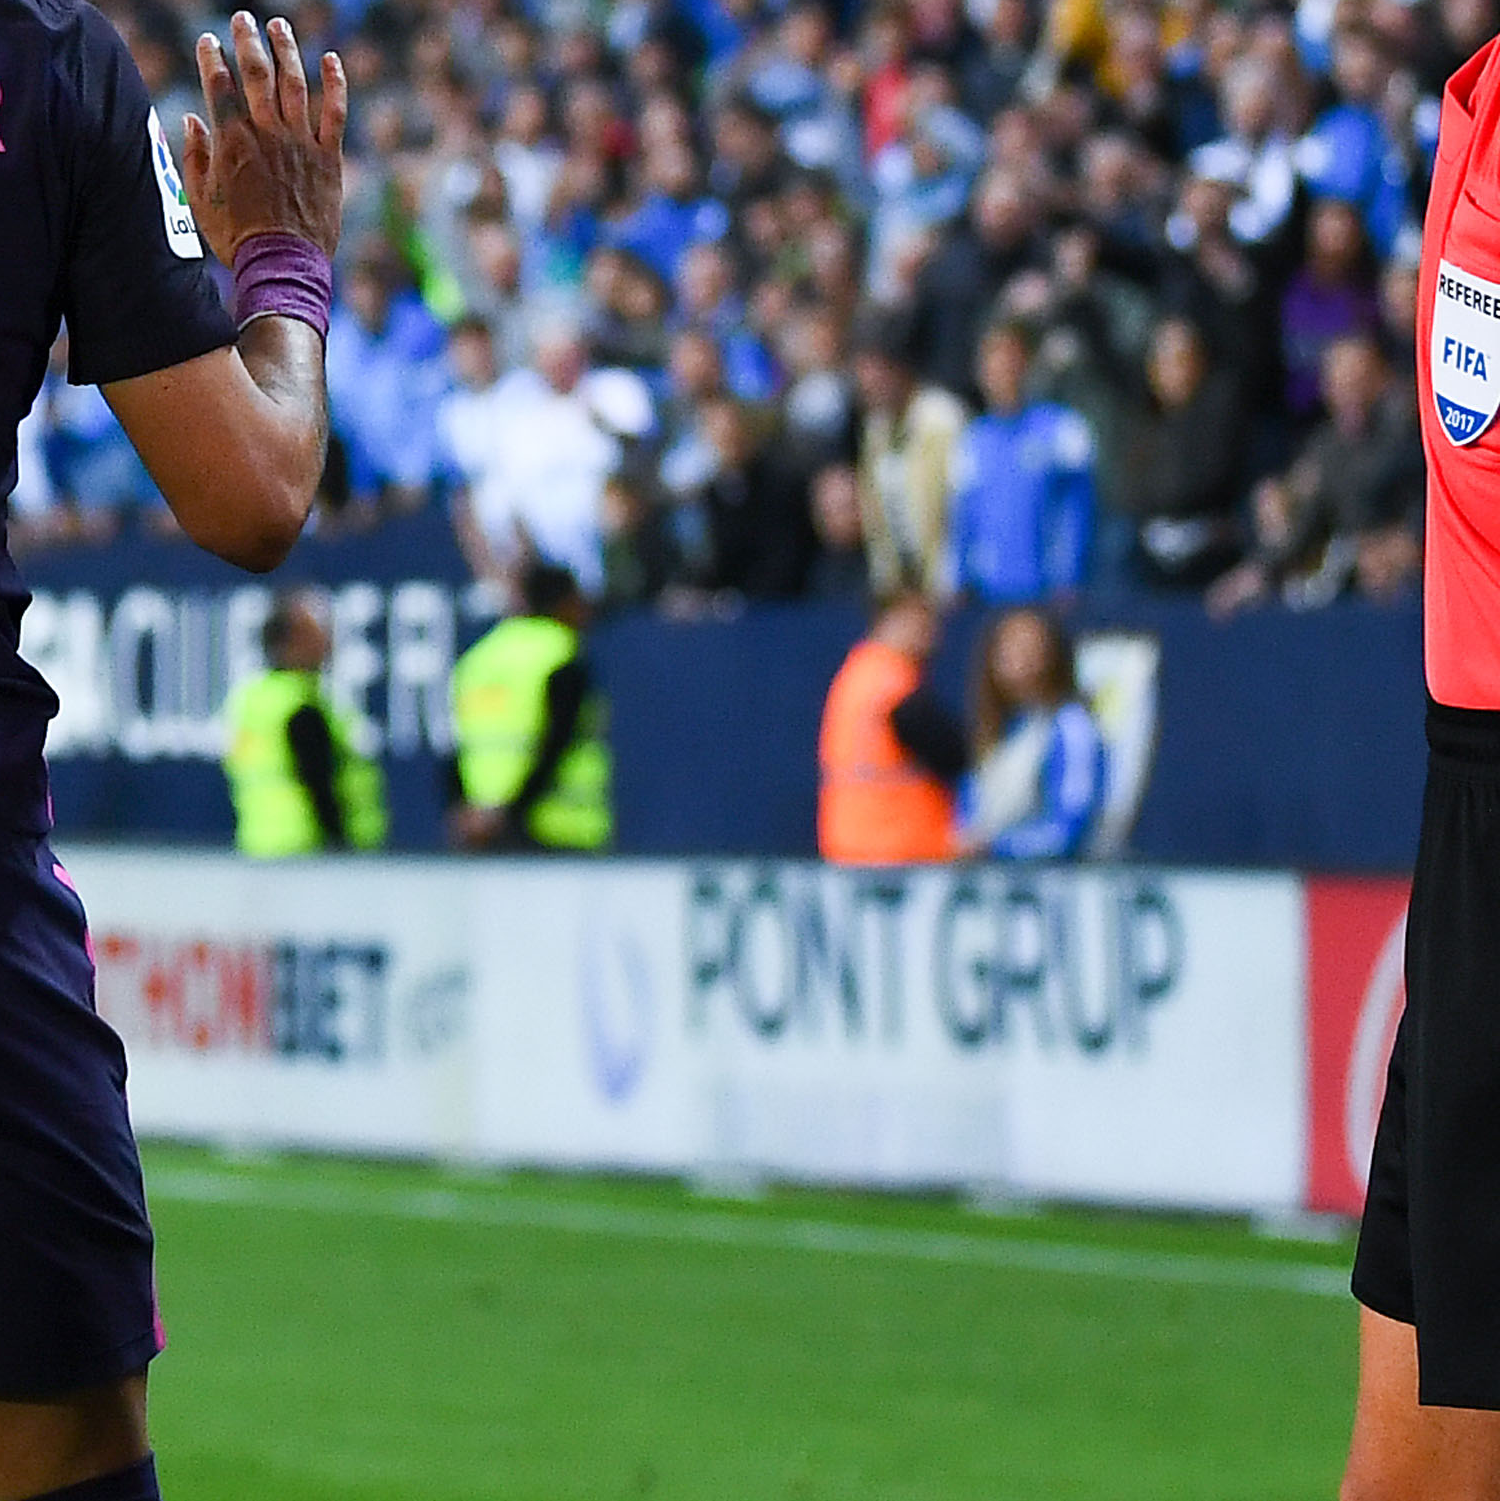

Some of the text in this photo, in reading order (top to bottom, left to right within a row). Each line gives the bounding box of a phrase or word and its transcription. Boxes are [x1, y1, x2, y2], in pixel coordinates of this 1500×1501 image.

[1442, 336, 1488, 382] FIFA
[1444, 406, 1475, 434] 2017
[683, 868, 908, 1045] PONT
[935, 870, 1184, 1060] GRUP
